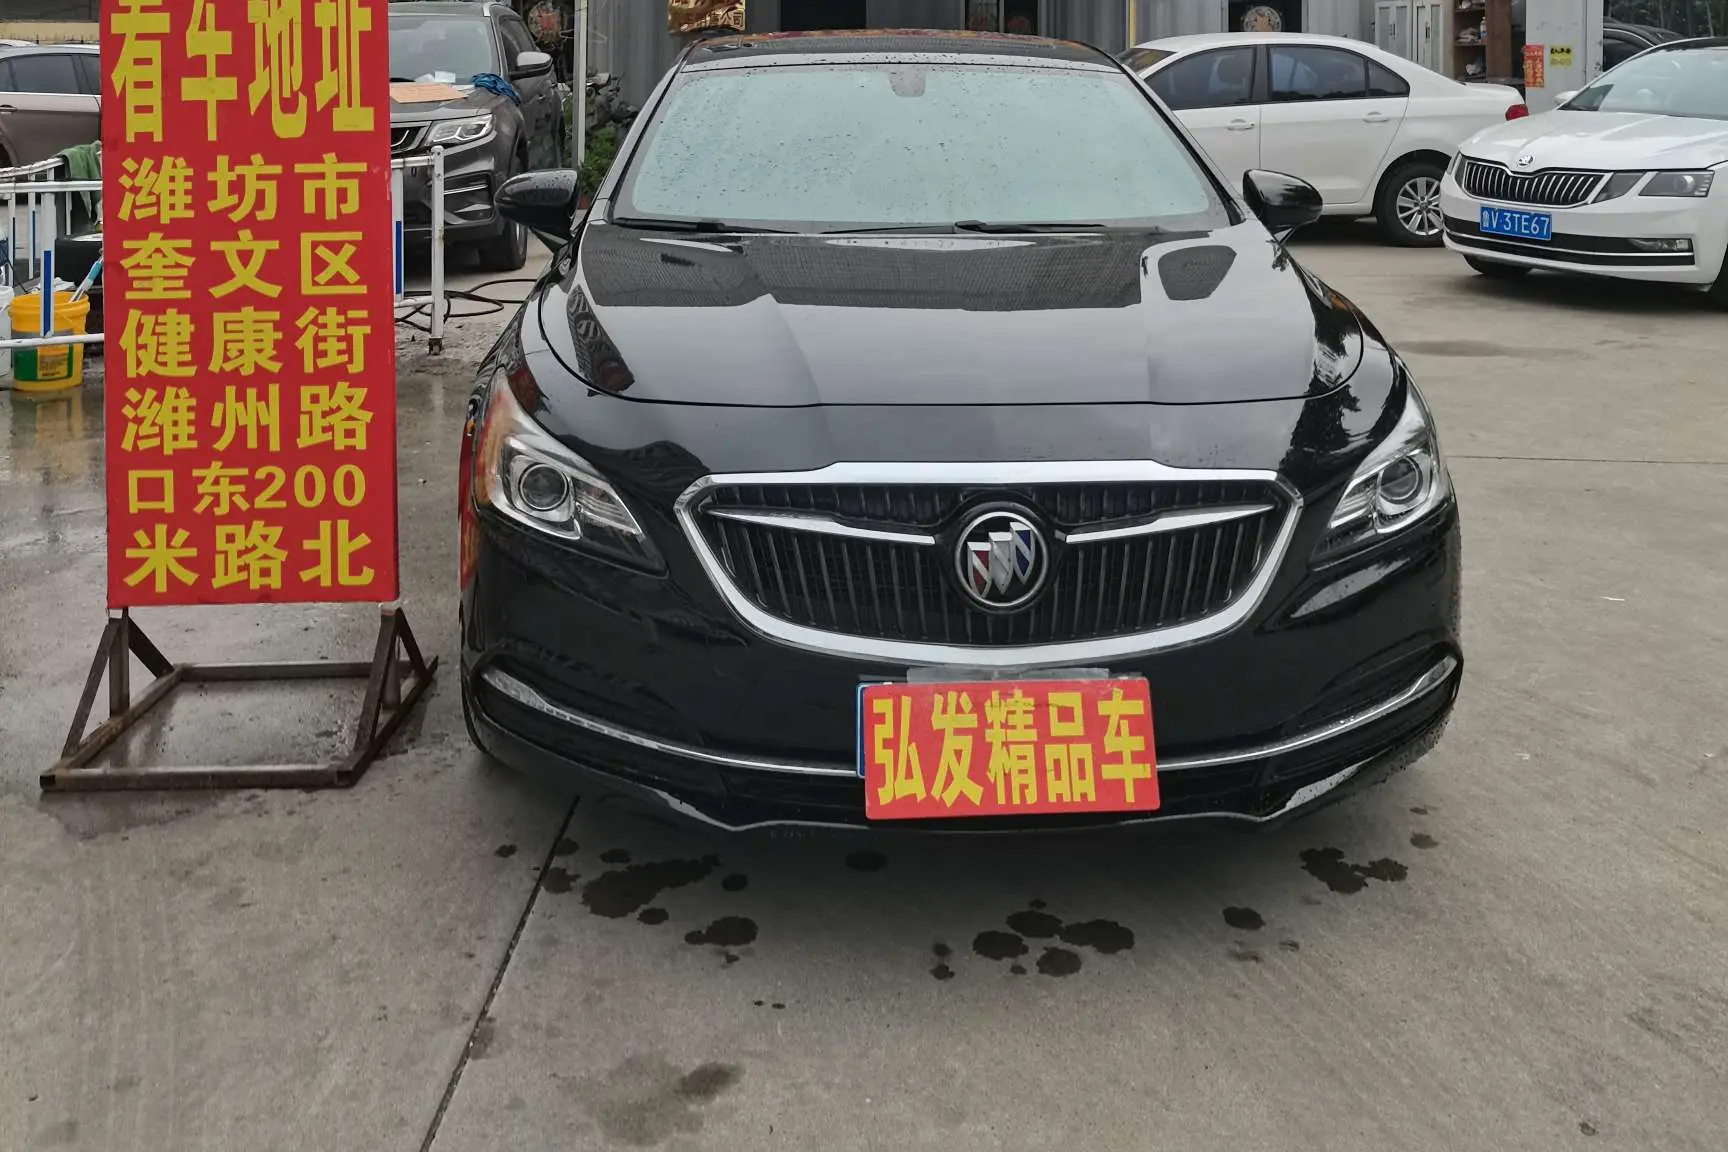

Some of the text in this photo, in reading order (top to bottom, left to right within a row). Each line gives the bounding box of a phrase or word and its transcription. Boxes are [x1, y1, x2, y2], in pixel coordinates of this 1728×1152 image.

[119, 152, 368, 224] 潍坊市
[120, 229, 368, 300] 奎文区
[119, 306, 372, 378] 健康街
[121, 381, 374, 456] 潍州路
[124, 519, 375, 593] 米路北
[872, 687, 1151, 808] 弘发精品车
